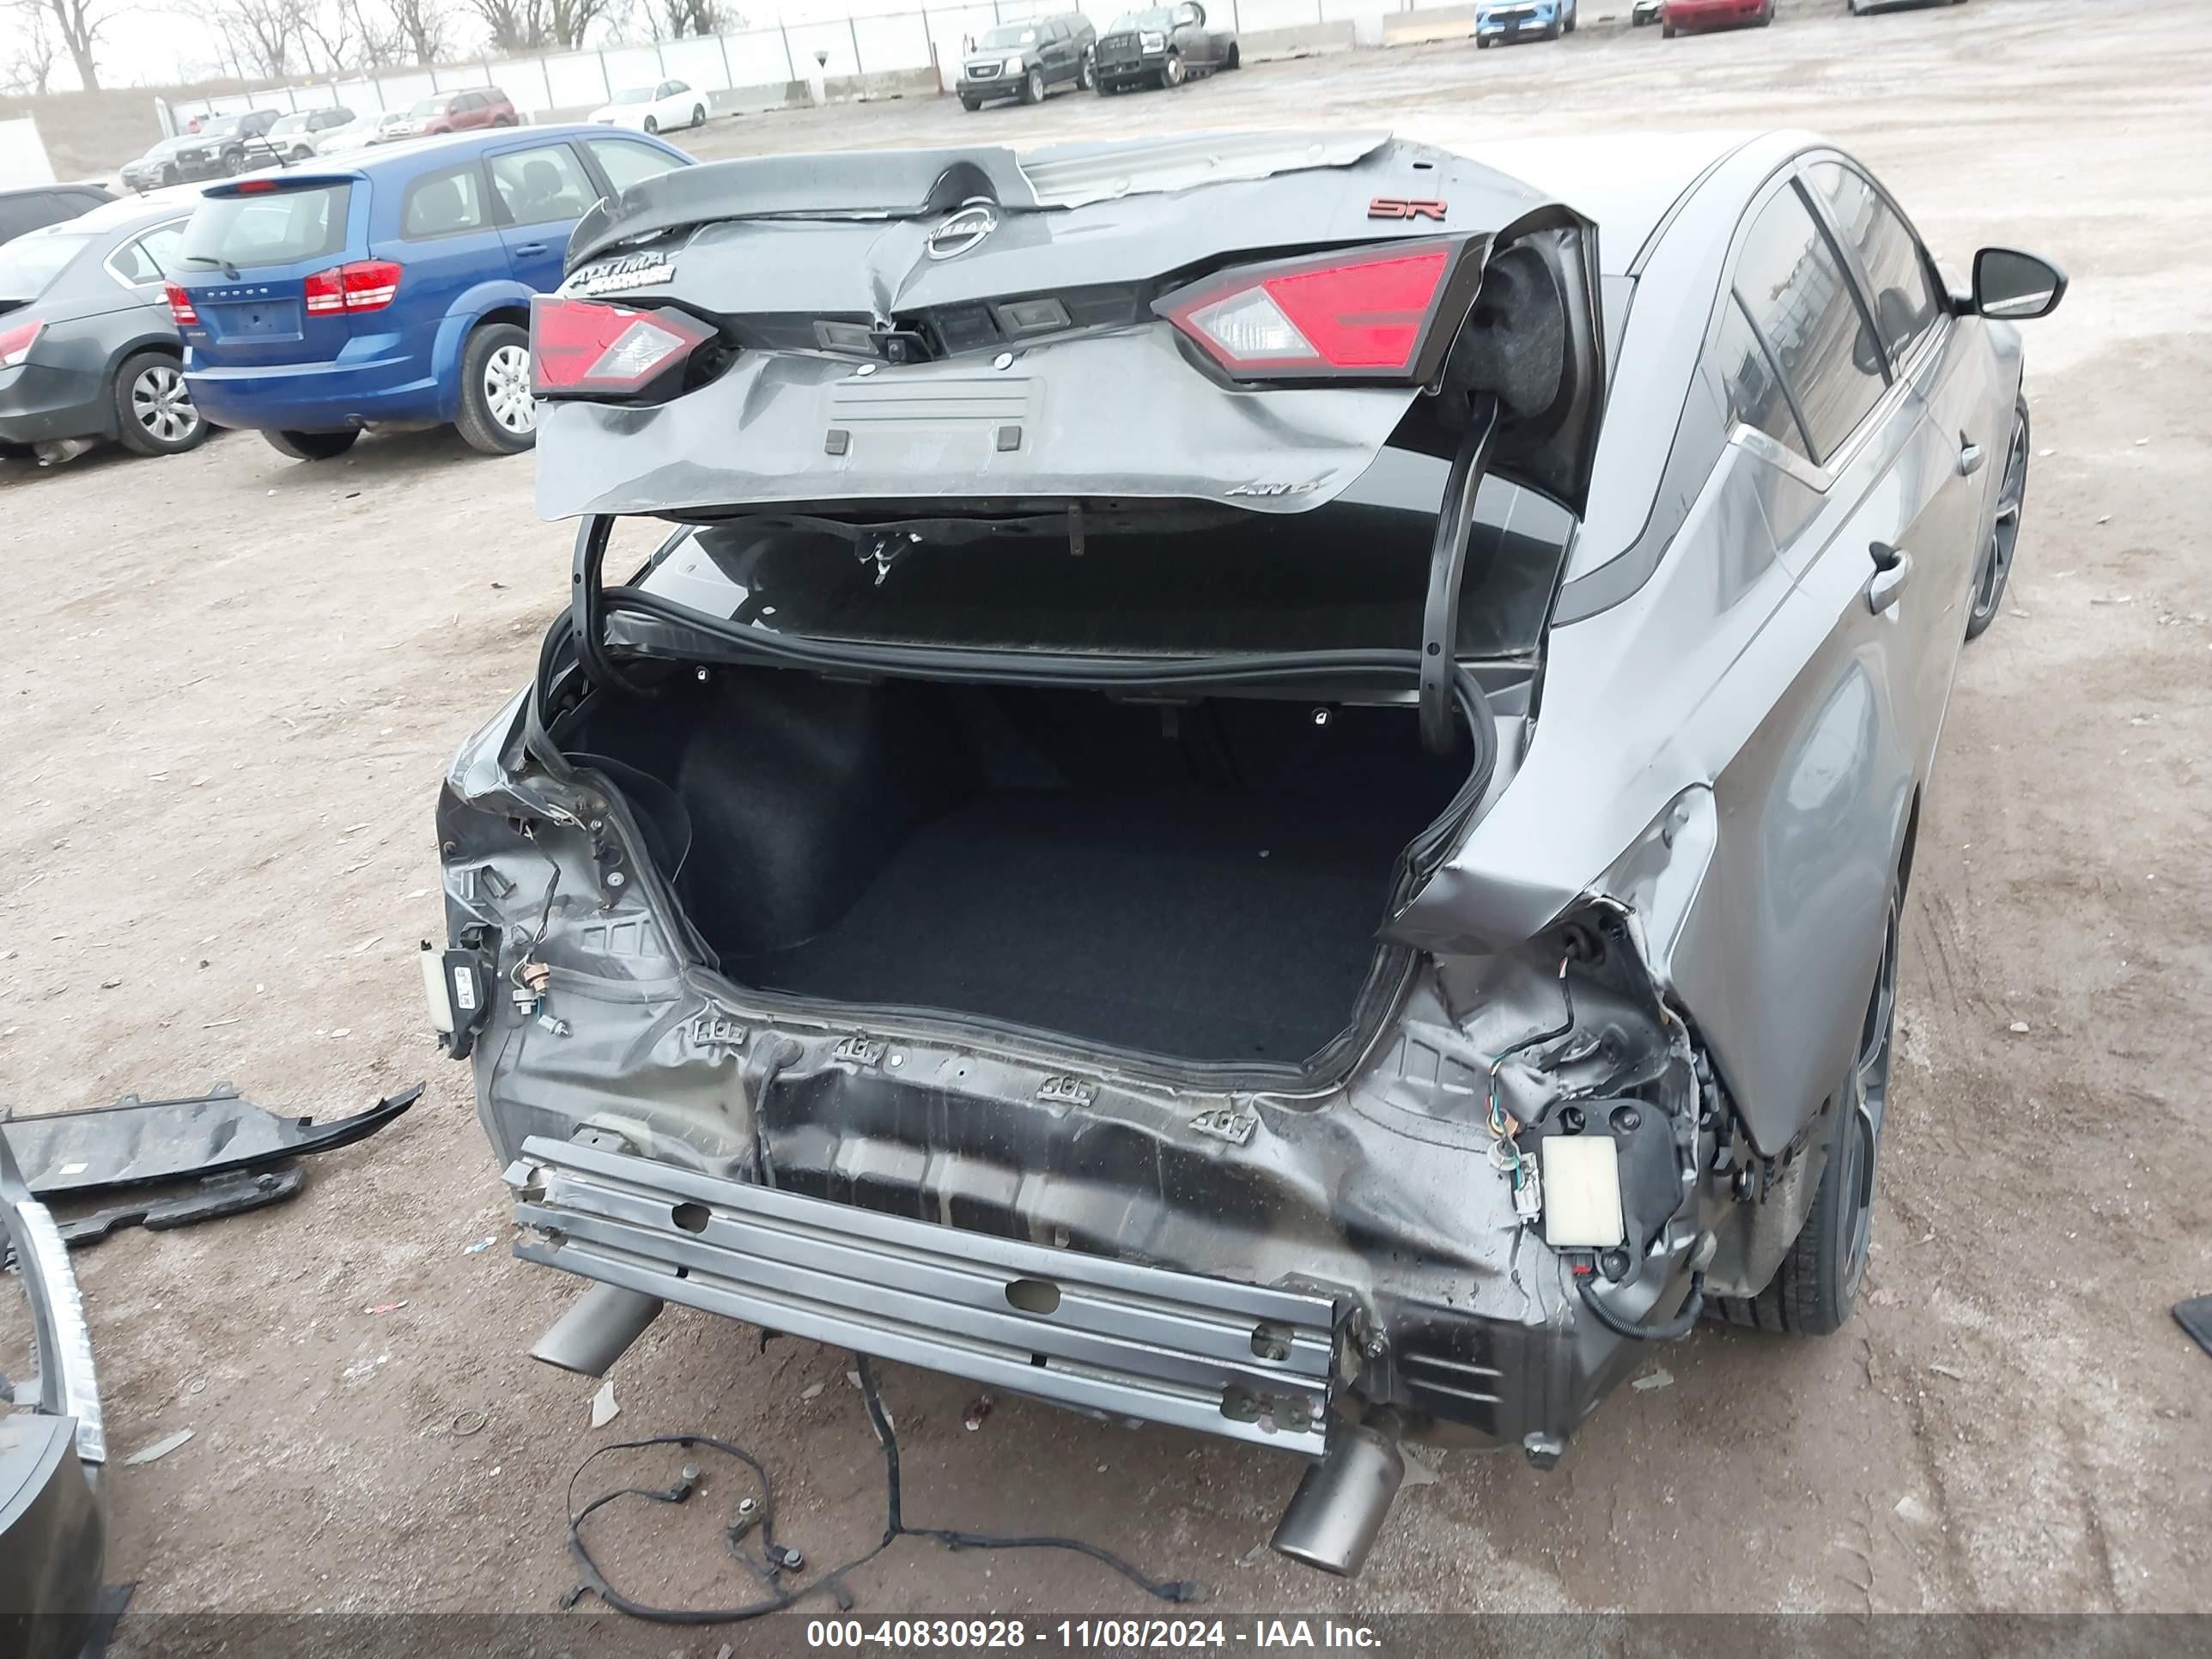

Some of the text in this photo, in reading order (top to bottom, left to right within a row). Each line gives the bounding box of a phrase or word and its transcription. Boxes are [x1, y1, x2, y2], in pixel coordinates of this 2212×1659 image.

[1367, 197, 1448, 222] SR
[927, 219, 999, 240] NISSAN
[568, 252, 666, 289] ALTIMA
